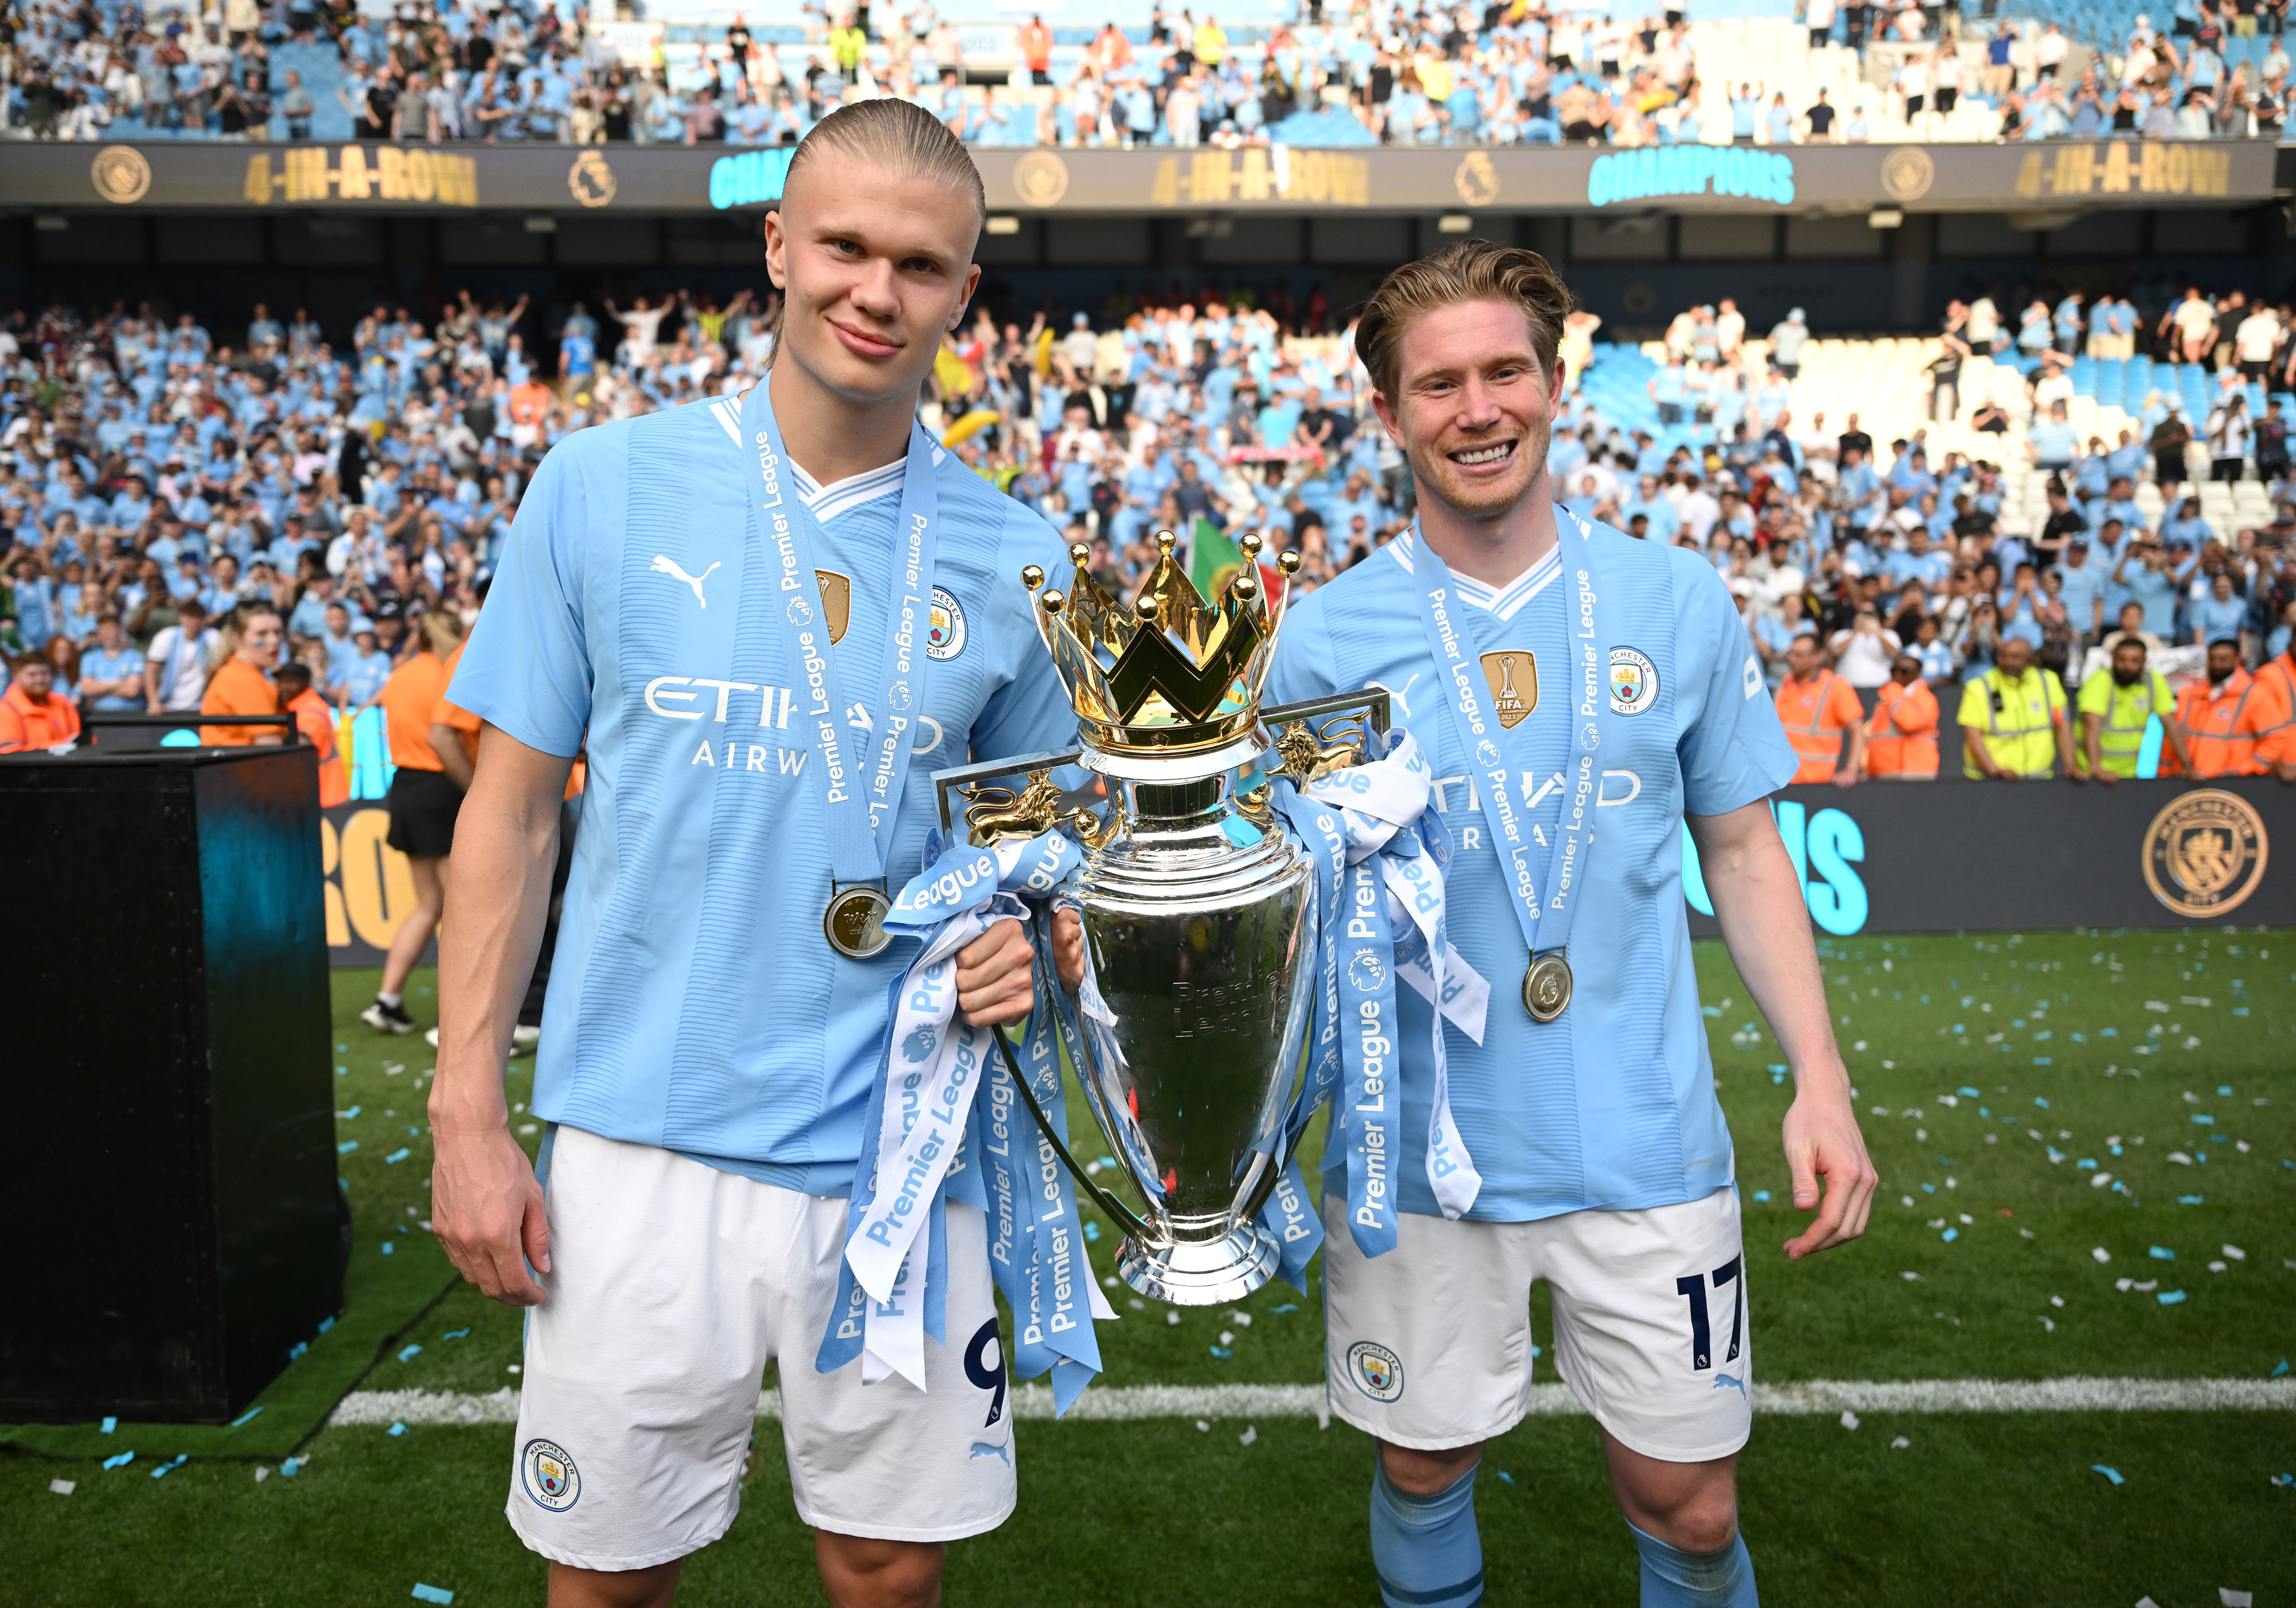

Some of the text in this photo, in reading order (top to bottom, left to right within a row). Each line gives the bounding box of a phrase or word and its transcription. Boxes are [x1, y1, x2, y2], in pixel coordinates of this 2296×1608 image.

[1588, 144, 1795, 206] CHAMPIONS
[756, 431, 802, 592] Premier League
[895, 513, 928, 674] Premier League
[931, 592, 961, 621] HESTER
[1577, 570, 1597, 717] Premier League
[927, 647, 946, 657] CITY
[1428, 588, 1486, 735] Premier League
[799, 632, 849, 804] Premier League
[873, 715, 908, 797] Premier
[894, 856, 994, 911] League
[1488, 769, 1540, 920] Premier League
[1551, 755, 1593, 910] Premier League
[1317, 814, 1346, 1045] Premier League
[1396, 857, 1440, 915] Pre
[1033, 950, 1050, 1062] Premier
[1173, 964, 1290, 1009] Premier
[1174, 994, 1289, 1038] League
[1356, 1000, 1391, 1230] Premier League
[866, 1128, 948, 1248] Premier
[992, 1161, 1013, 1266] Premier
[836, 1277, 867, 1339] Pre
[1047, 1227, 1077, 1333] Premier
[1676, 1251, 1742, 1371] 17
[964, 1317, 1006, 1428] 9
[1353, 1345, 1399, 1371] MANCHESTER
[1368, 1388, 1386, 1398] CITY
[529, 1443, 575, 1475] MANCHESTER
[541, 1494, 558, 1506] CITY
